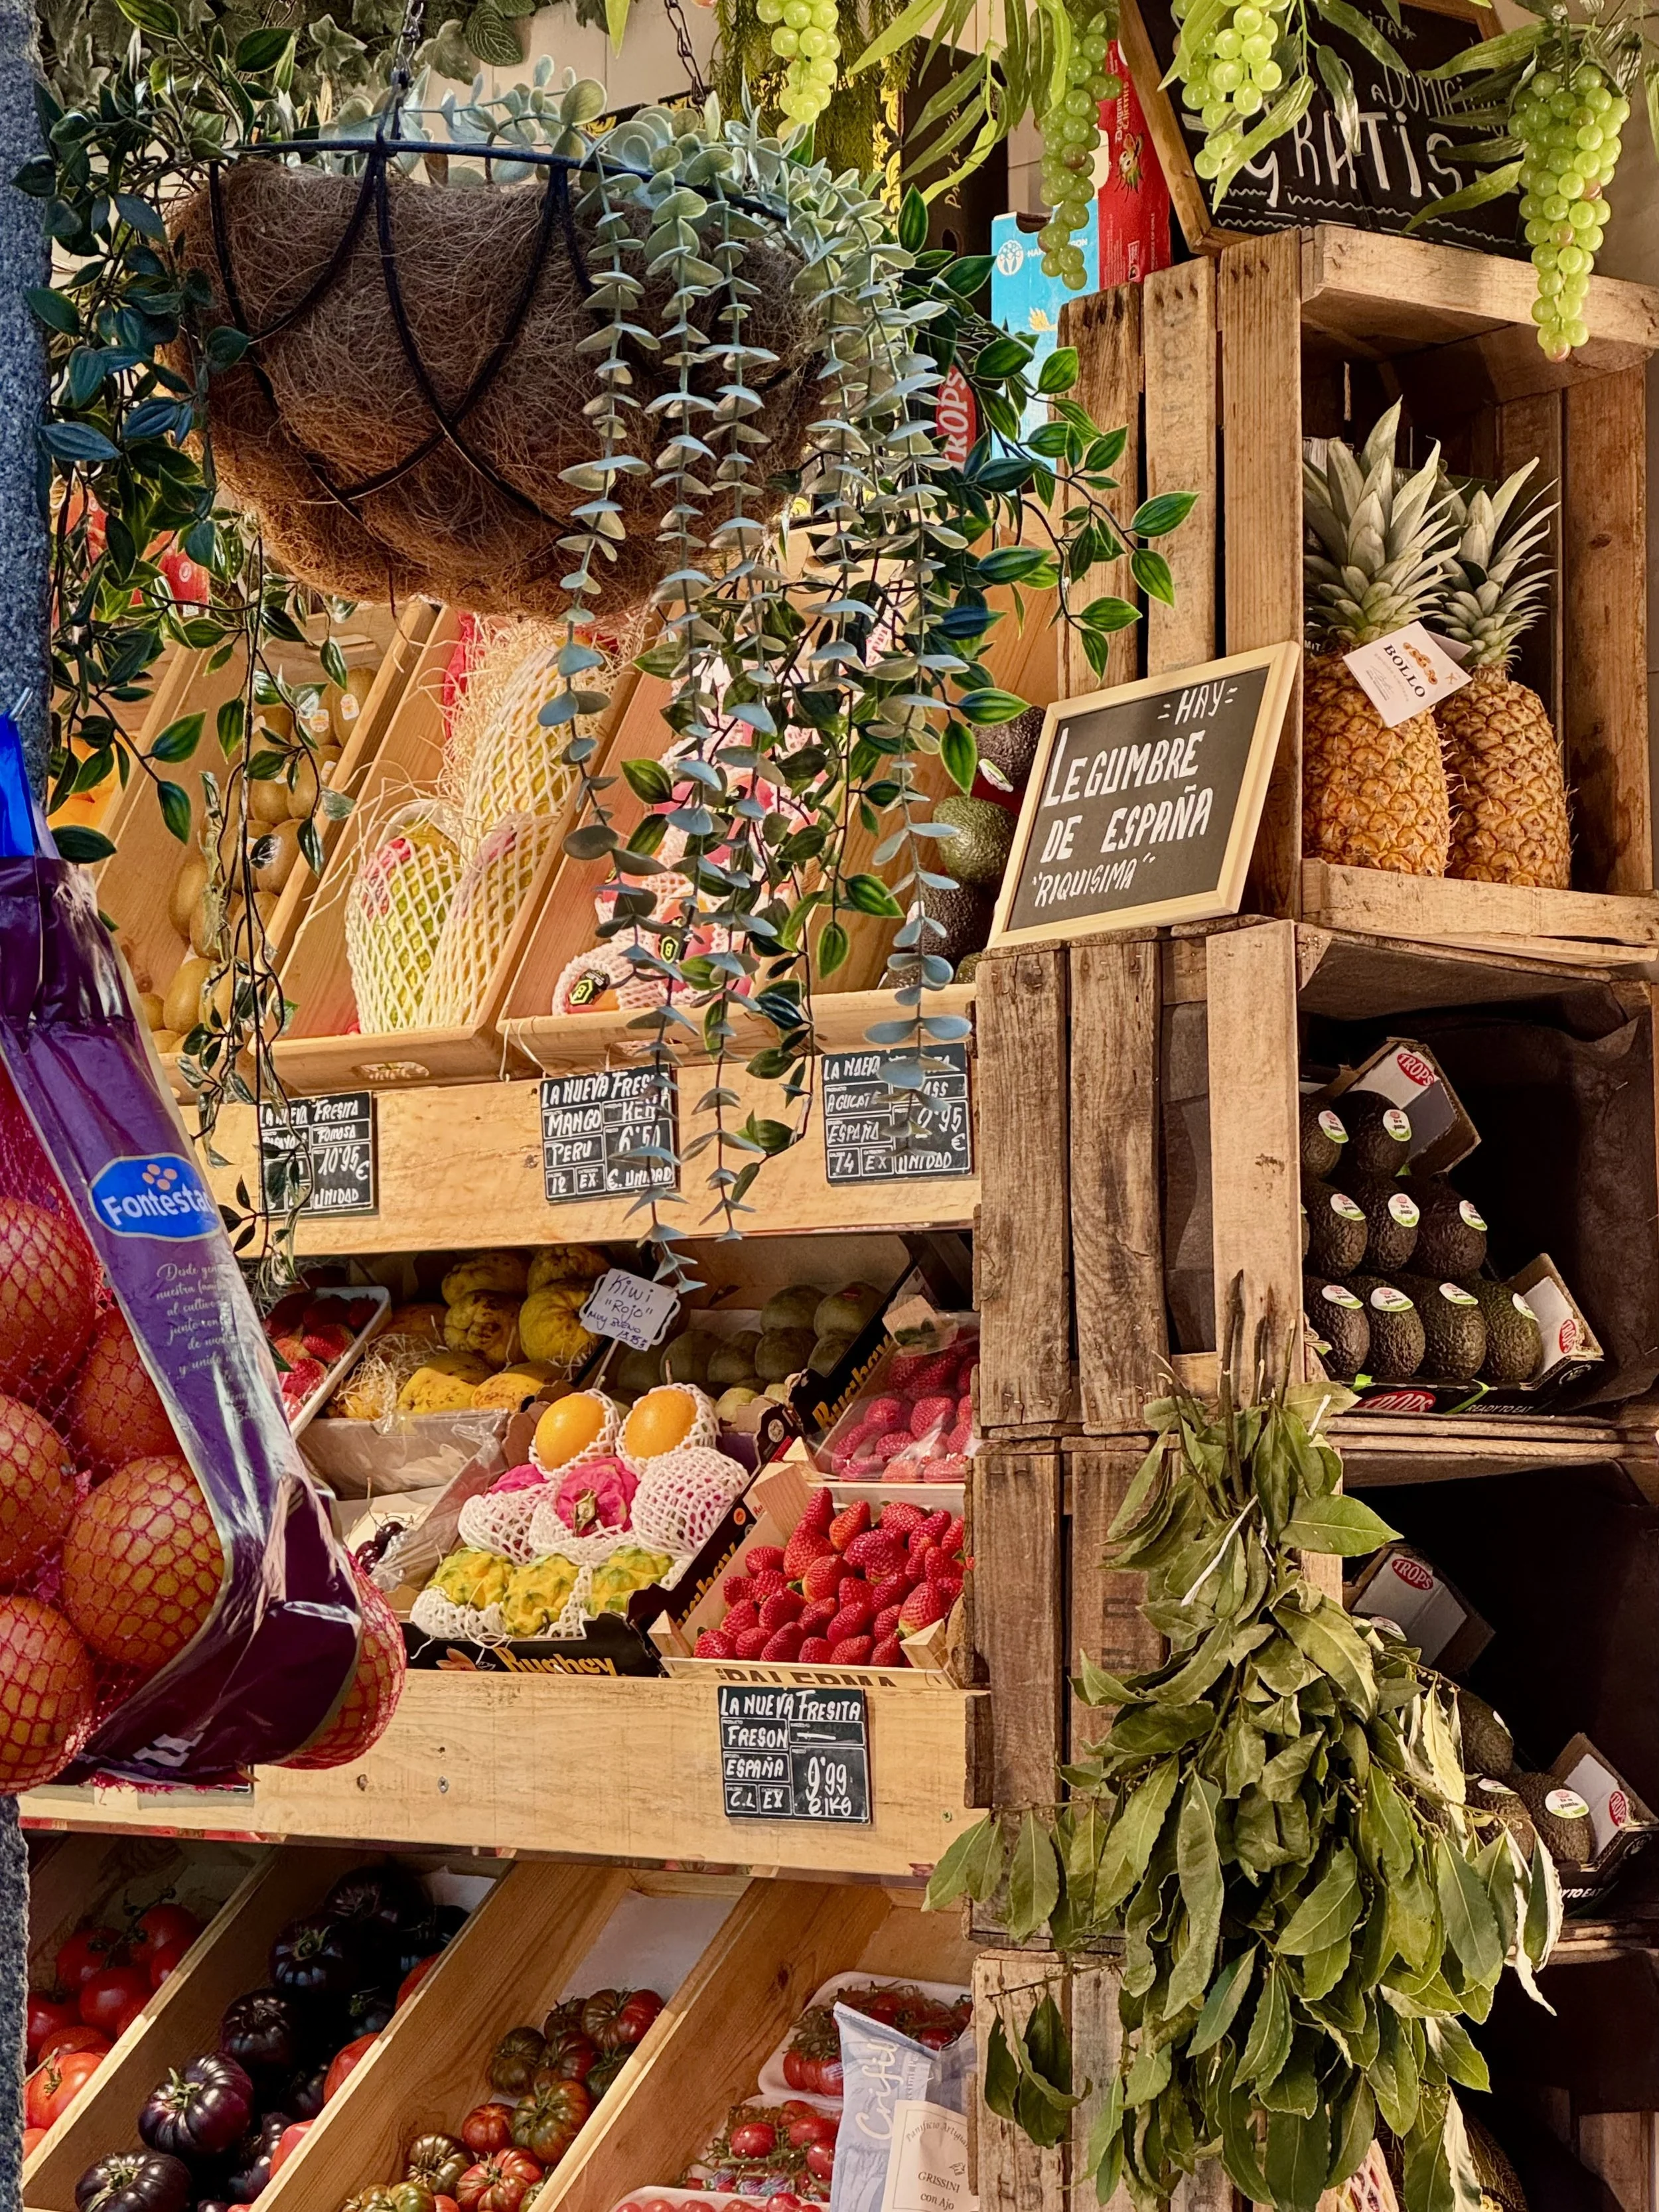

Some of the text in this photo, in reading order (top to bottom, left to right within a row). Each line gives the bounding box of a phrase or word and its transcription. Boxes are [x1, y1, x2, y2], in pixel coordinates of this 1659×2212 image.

[1384, 644, 1425, 697] BOLLO
[1043, 727, 1205, 807] LEGUMBRE
[1041, 784, 1213, 863] DE ESPAÑA
[824, 1059, 839, 1080] LA
[1398, 1054, 1433, 1086] TROPS
[541, 1082, 560, 1108] LA
[563, 1073, 609, 1104] NUEVA
[923, 1081, 949, 1098] ASS
[312, 1099, 358, 1122] FRESITA
[622, 1097, 666, 1123] KEN
[547, 1109, 601, 1137] MANGO
[828, 1120, 880, 1144] ESPAÑA
[551, 1140, 593, 1166] PERU
[899, 1151, 953, 1173] UNIDAD
[315, 1188, 359, 1208] UNIDAD
[157, 1263, 198, 1281] Desde
[167, 1302, 179, 1317] al
[1394, 1560, 1431, 1589] TROPS
[721, 1688, 861, 1722] LA NUEVA FRESITA
[728, 1726, 788, 1748] FRESON
[726, 1757, 784, 1779] ESPAÑA
[762, 1791, 783, 1809] EX
[918, 2170, 961, 2194] GRISSINI
[920, 2191, 955, 2211] con Ajo
